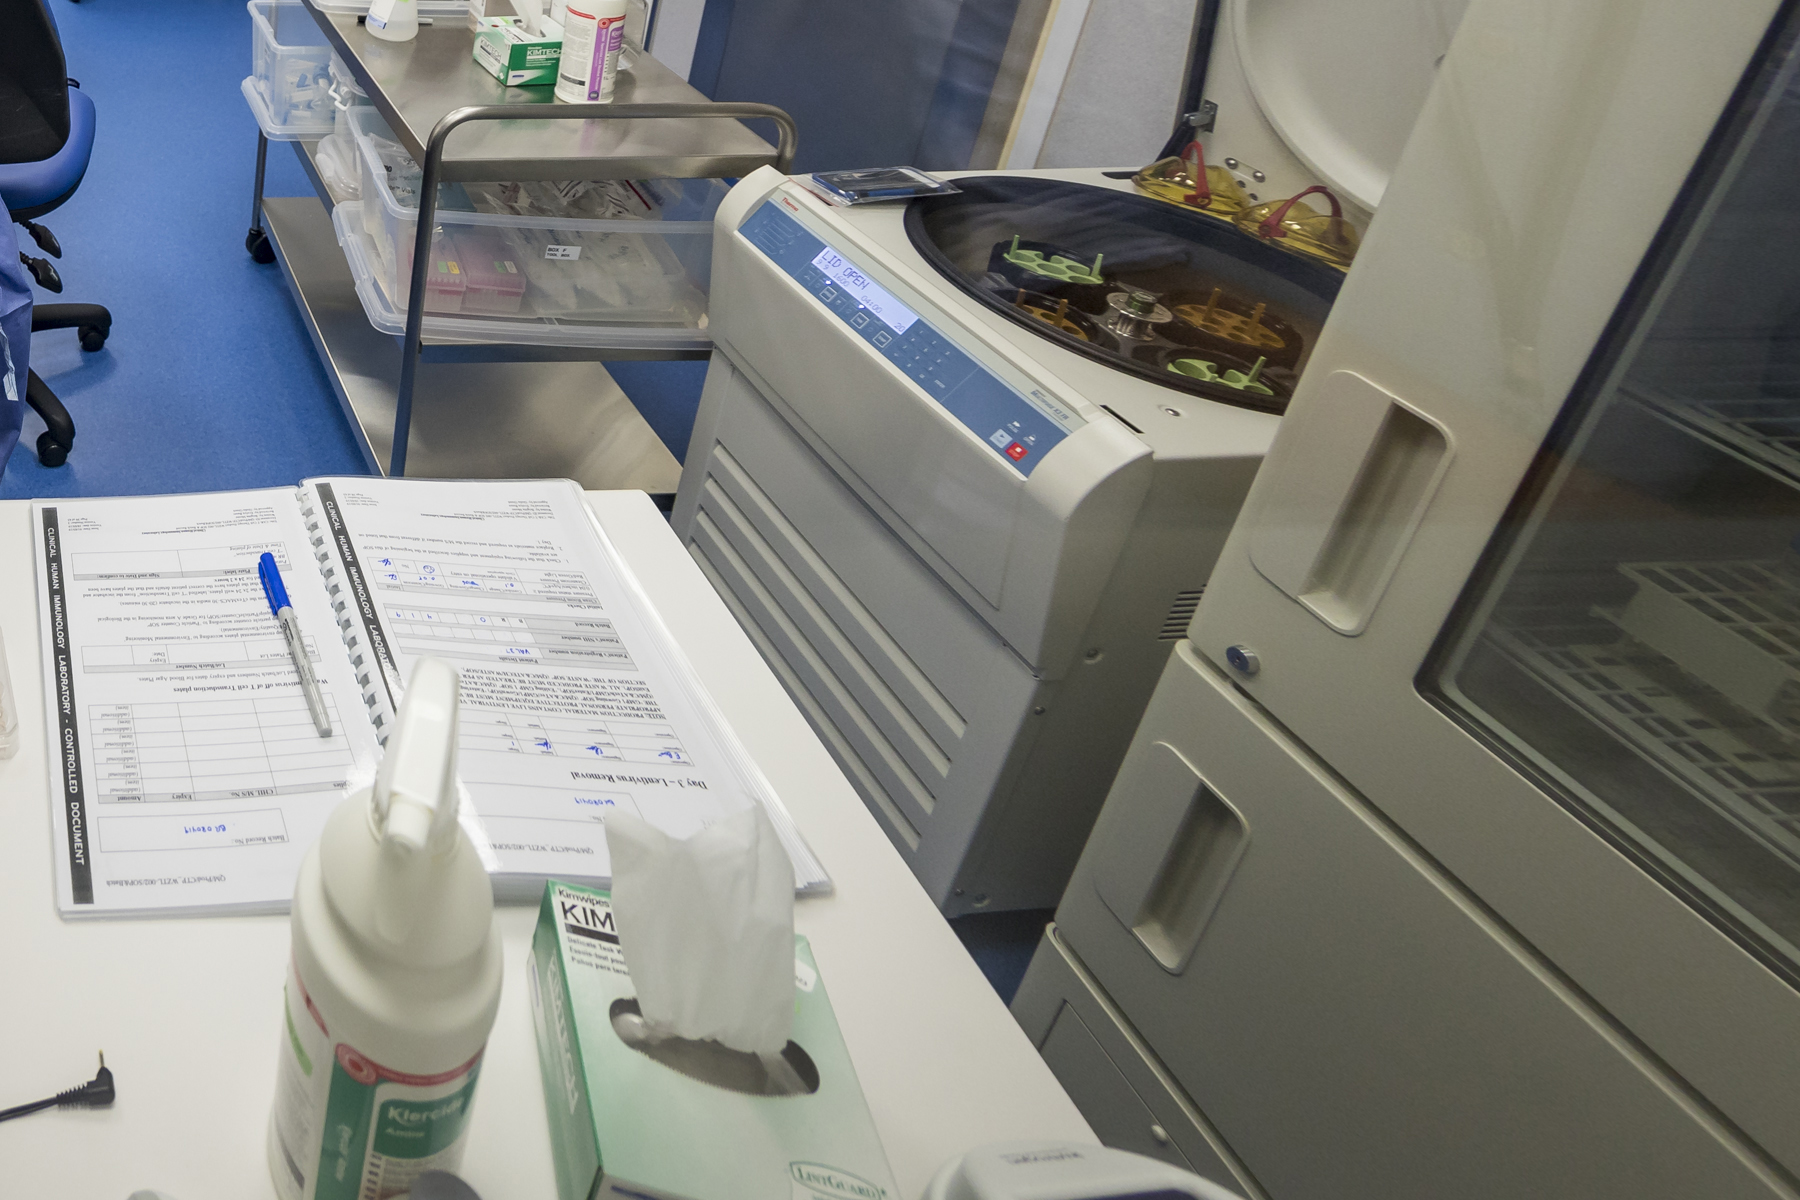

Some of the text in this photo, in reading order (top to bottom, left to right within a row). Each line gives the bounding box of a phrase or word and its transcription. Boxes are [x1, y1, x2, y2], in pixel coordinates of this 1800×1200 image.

[821, 250, 870, 291] LID OPEN
[833, 272, 850, 288] 1600
[861, 295, 883, 315] 04:00
[894, 322, 906, 333] 20
[47, 527, 57, 558] CLINICAL
[326, 501, 341, 531] CLINICAL
[338, 535, 353, 562] HUMAN
[349, 566, 373, 619] IMMUNOLOGY
[51, 563, 60, 589] HUMAN
[53, 594, 65, 649] IMMUNOLOGY
[570, 650, 602, 658] Registration
[59, 655, 71, 715] LABORATORY
[193, 684, 235, 692] Transduction
[64, 727, 78, 794] CONTROLLED
[570, 771, 616, 784] Removal
[616, 774, 668, 787] Lentivirus
[677, 780, 685, 788] 3
[686, 778, 708, 790] Day
[70, 802, 84, 865] DOCUMENT
[245, 836, 267, 844] Record
[558, 888, 610, 908] Kimwipes
